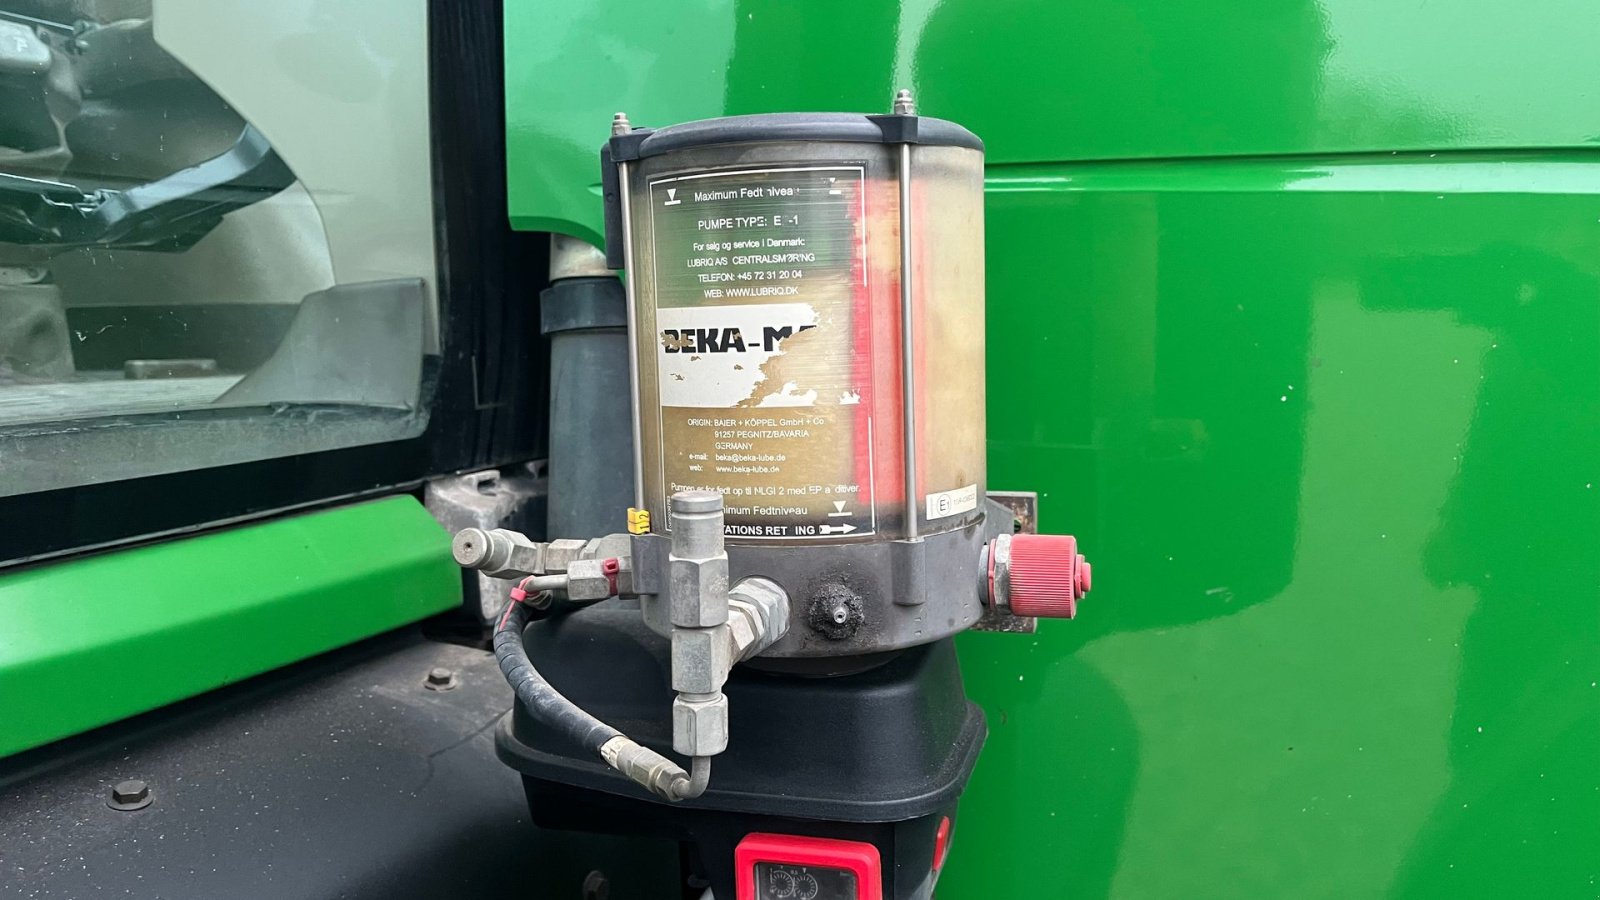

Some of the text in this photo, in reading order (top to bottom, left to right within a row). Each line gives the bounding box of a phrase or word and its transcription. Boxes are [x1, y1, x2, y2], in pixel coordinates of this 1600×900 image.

[694, 190, 738, 202] Maximum
[698, 215, 799, 230] PUMPE TYPE: E-1
[693, 242, 704, 252] For
[706, 241, 720, 252] salg
[721, 242, 732, 252] og
[733, 240, 760, 249] service
[687, 257, 715, 268] LUBRIQ
[715, 256, 728, 266] A/S
[698, 269, 803, 283] TELEFON: +45 72 31 20 04
[704, 286, 799, 298] WEB: WWW.LUBRIQ.DK
[664, 325, 817, 353] BEKA-M
[687, 418, 713, 427] ORIGIN:
[714, 419, 736, 427] BAIER
[744, 417, 778, 427] KÖPPEL
[779, 417, 804, 426] GmbH
[812, 417, 824, 425] Co
[714, 429, 809, 439] 91257 PEGNITZ/BAVARIA
[715, 442, 753, 450] GERMANY
[715, 453, 786, 463] beka@beka-lube.de
[715, 465, 780, 473] www.beka-lube.de
[717, 485, 731, 495] fedt
[733, 488, 743, 497] op
[754, 486, 776, 495] NLGI
[778, 486, 785, 495] 2
[787, 486, 806, 495] med
[809, 485, 822, 494] EP
[753, 505, 808, 515] Fedtniveau
[724, 525, 815, 535] ATIONS RETING
